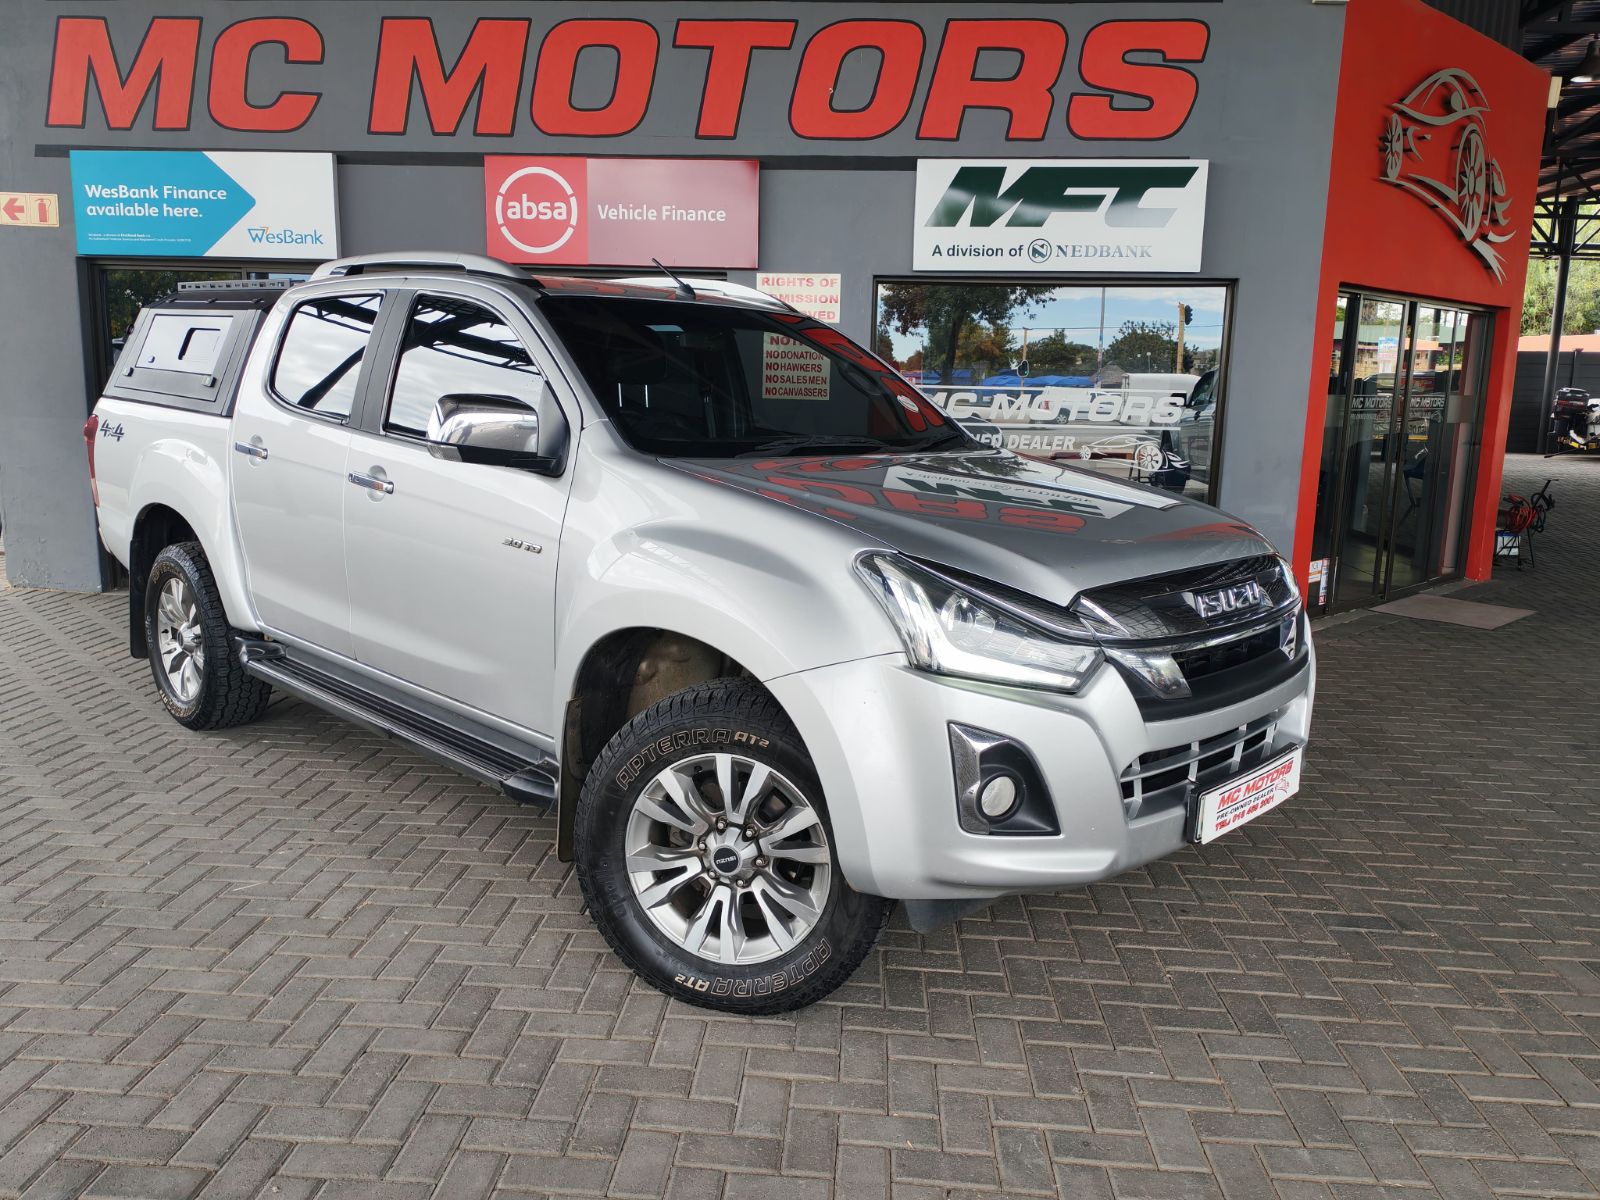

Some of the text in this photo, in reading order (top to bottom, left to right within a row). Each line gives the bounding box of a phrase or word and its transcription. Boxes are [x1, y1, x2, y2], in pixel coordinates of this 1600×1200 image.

[45, 16, 1210, 141] MC MOTORS
[84, 184, 227, 200] WesBank Finance
[924, 166, 1199, 228] MFC
[86, 202, 203, 218] available here.
[506, 193, 567, 220] absa
[597, 203, 726, 222] Vehicle Finance
[247, 227, 324, 245] WesBank
[932, 244, 1153, 258] A division of NEDBANK
[761, 277, 839, 288] RIGHTS OF
[765, 350, 780, 359] NO
[765, 362, 823, 373] NO HAWKERS
[765, 374, 779, 384] NO
[765, 386, 828, 397] NO CANVASSERS
[989, 393, 1186, 424] MOTORS
[1007, 434, 1076, 451] DEALER
[1197, 582, 1260, 618] ISUZU
[615, 728, 770, 791] APTERRA AT2
[1217, 760, 1293, 811] MC MOTORS
[1216, 787, 1274, 821] PRE-OWNED DEALER
[674, 937, 832, 998] APTERRA AT2
